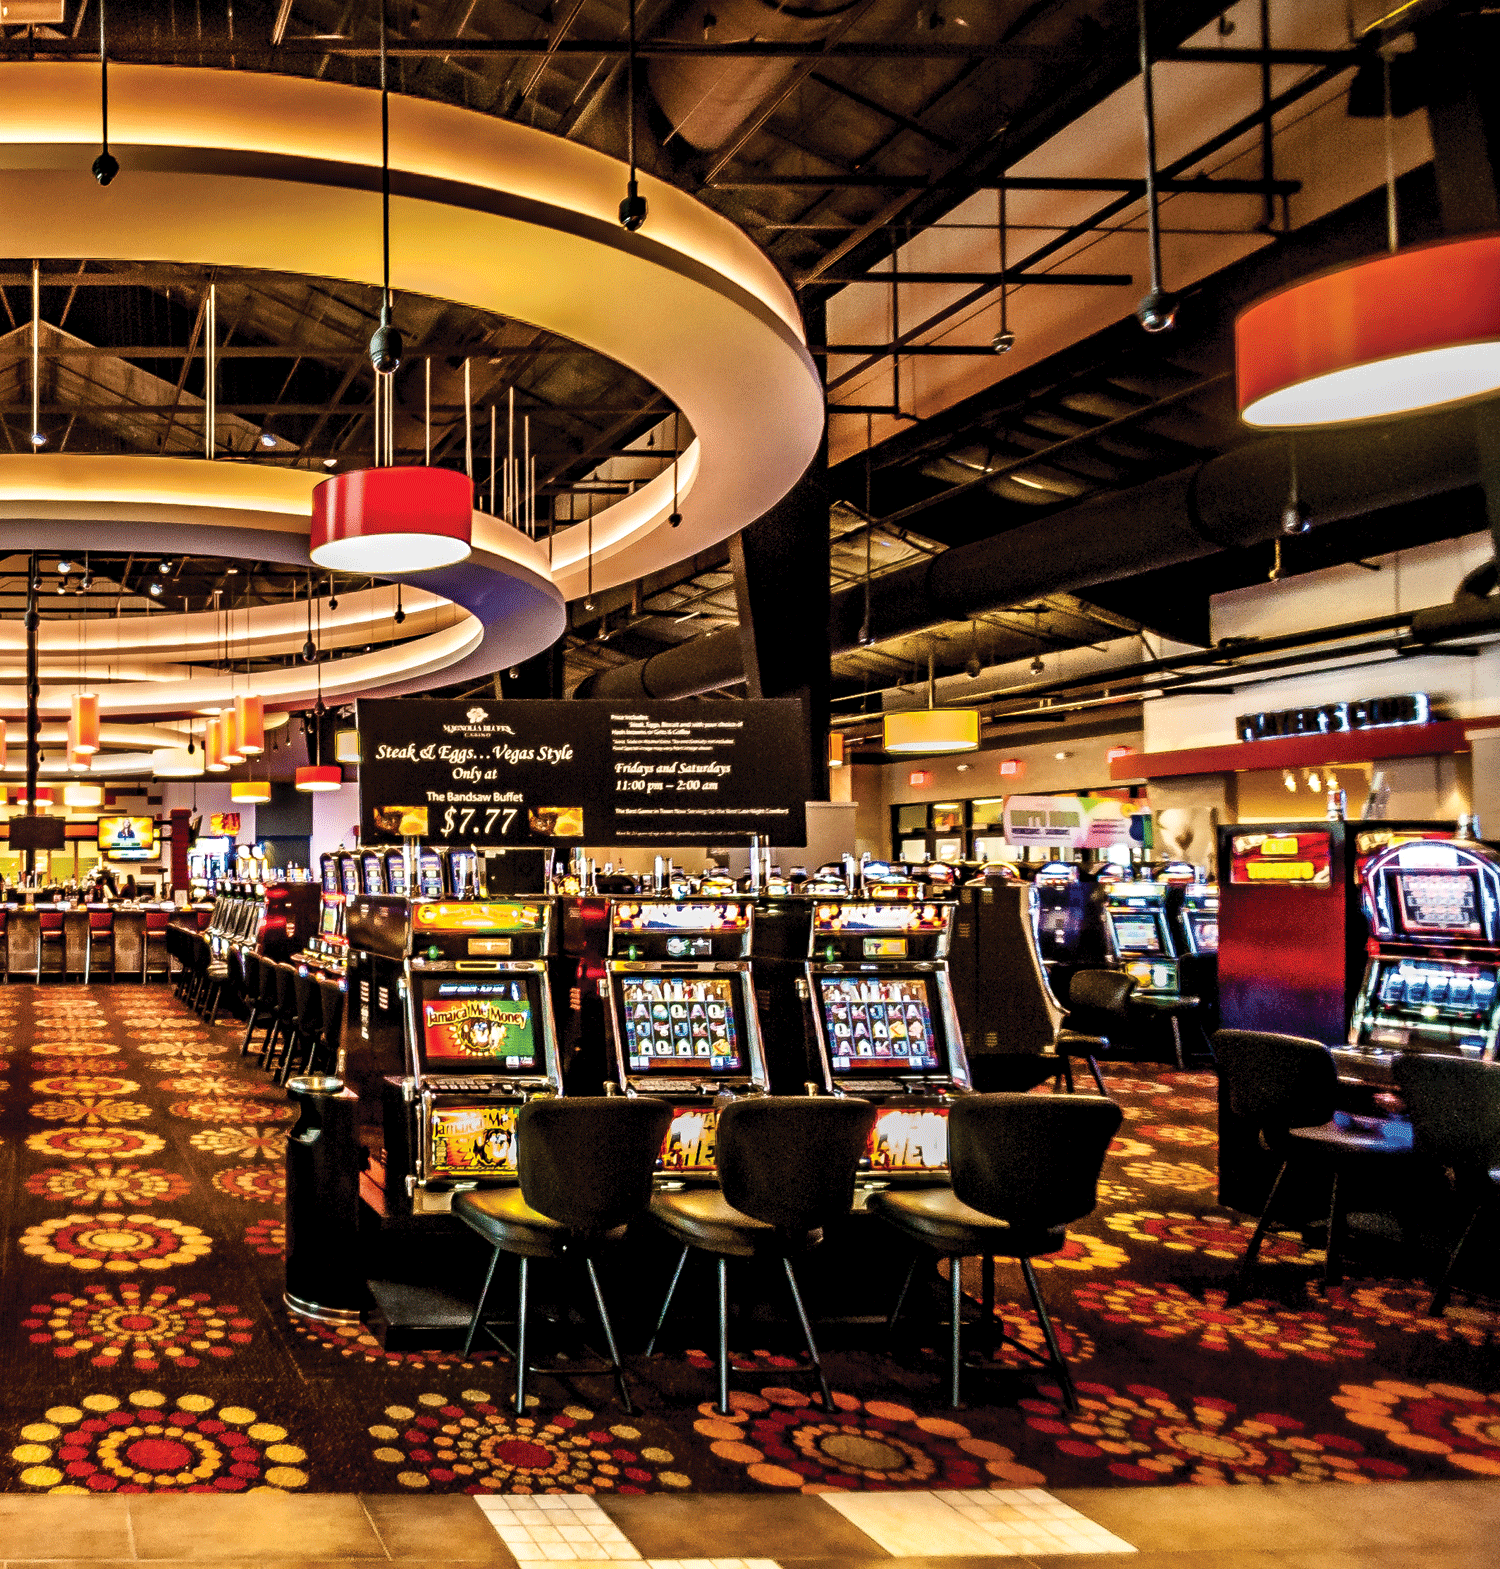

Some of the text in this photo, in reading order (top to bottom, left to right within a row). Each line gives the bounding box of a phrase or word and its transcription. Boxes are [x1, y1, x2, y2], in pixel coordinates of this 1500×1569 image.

[376, 744, 420, 762] Steak
[420, 744, 437, 760] &
[536, 744, 574, 764] Style
[452, 766, 498, 783] Only at
[614, 761, 732, 776] Fridays and Saturdays
[616, 780, 646, 790] 11:00
[646, 782, 664, 794] pm
[676, 780, 700, 790] 2:00
[702, 782, 718, 790] am
[426, 792, 524, 802] The Bandsaw Buffet
[440, 805, 518, 838] $7.77
[426, 1006, 467, 1028] Jamaica
[490, 1008, 528, 1029] Money
